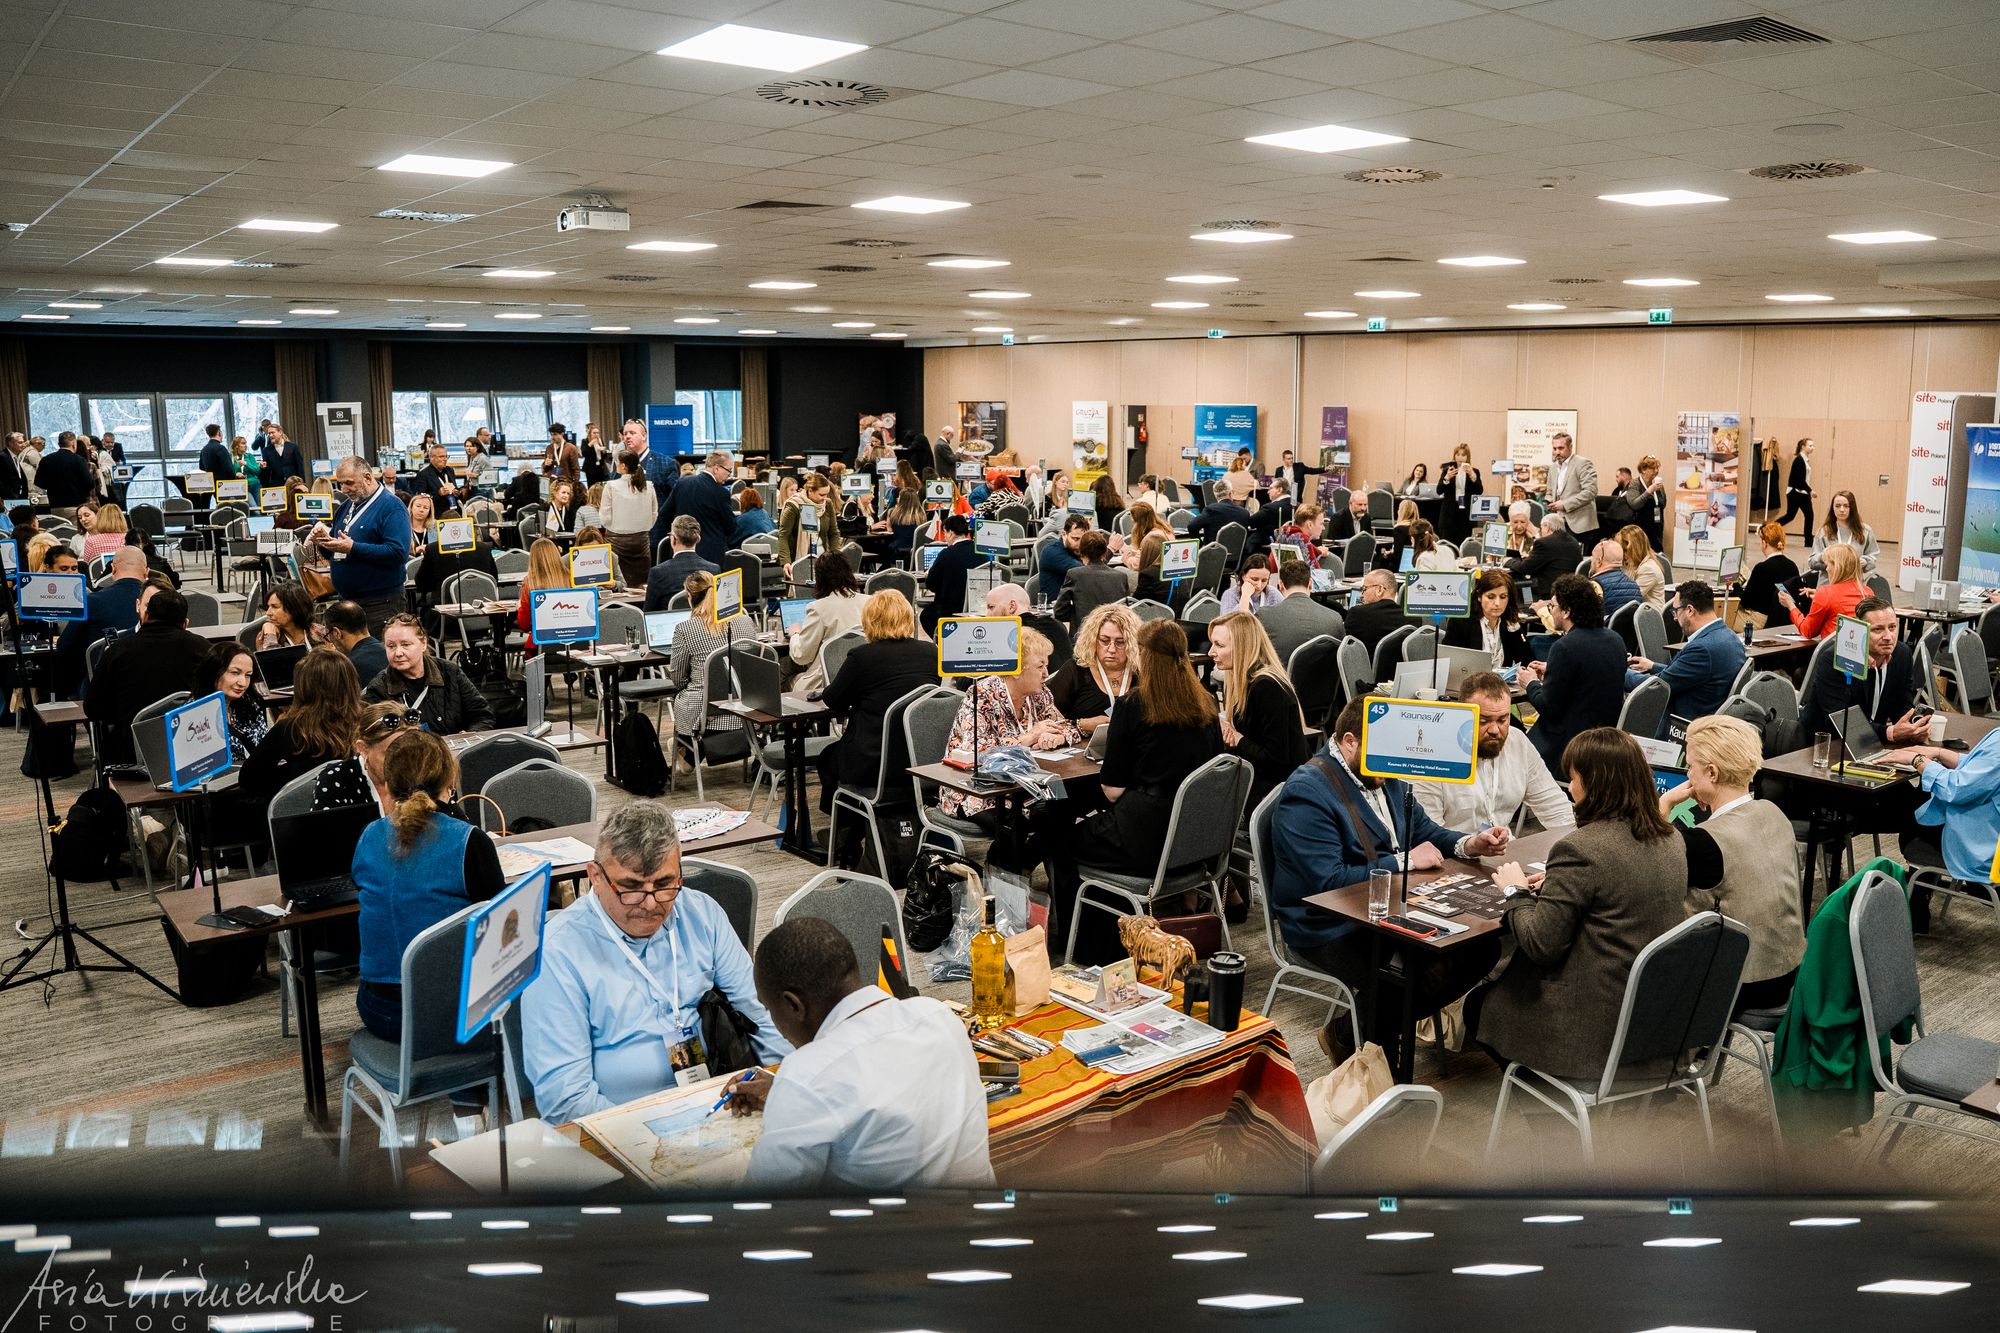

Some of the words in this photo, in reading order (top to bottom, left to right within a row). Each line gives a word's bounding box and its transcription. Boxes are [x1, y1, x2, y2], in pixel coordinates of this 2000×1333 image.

[1916, 393, 1936, 403] site
[1937, 420, 1951, 431] sit
[1911, 446, 1930, 458] site
[1906, 501, 1925, 513] site
[1902, 556, 1921, 568] site
[1844, 640, 1858, 651] OSIRIS
[1371, 704, 1385, 714] 45
[1401, 711, 1431, 721] Kaunas
[171, 717, 179, 729] 63
[1669, 724, 1687, 740] Kaun
